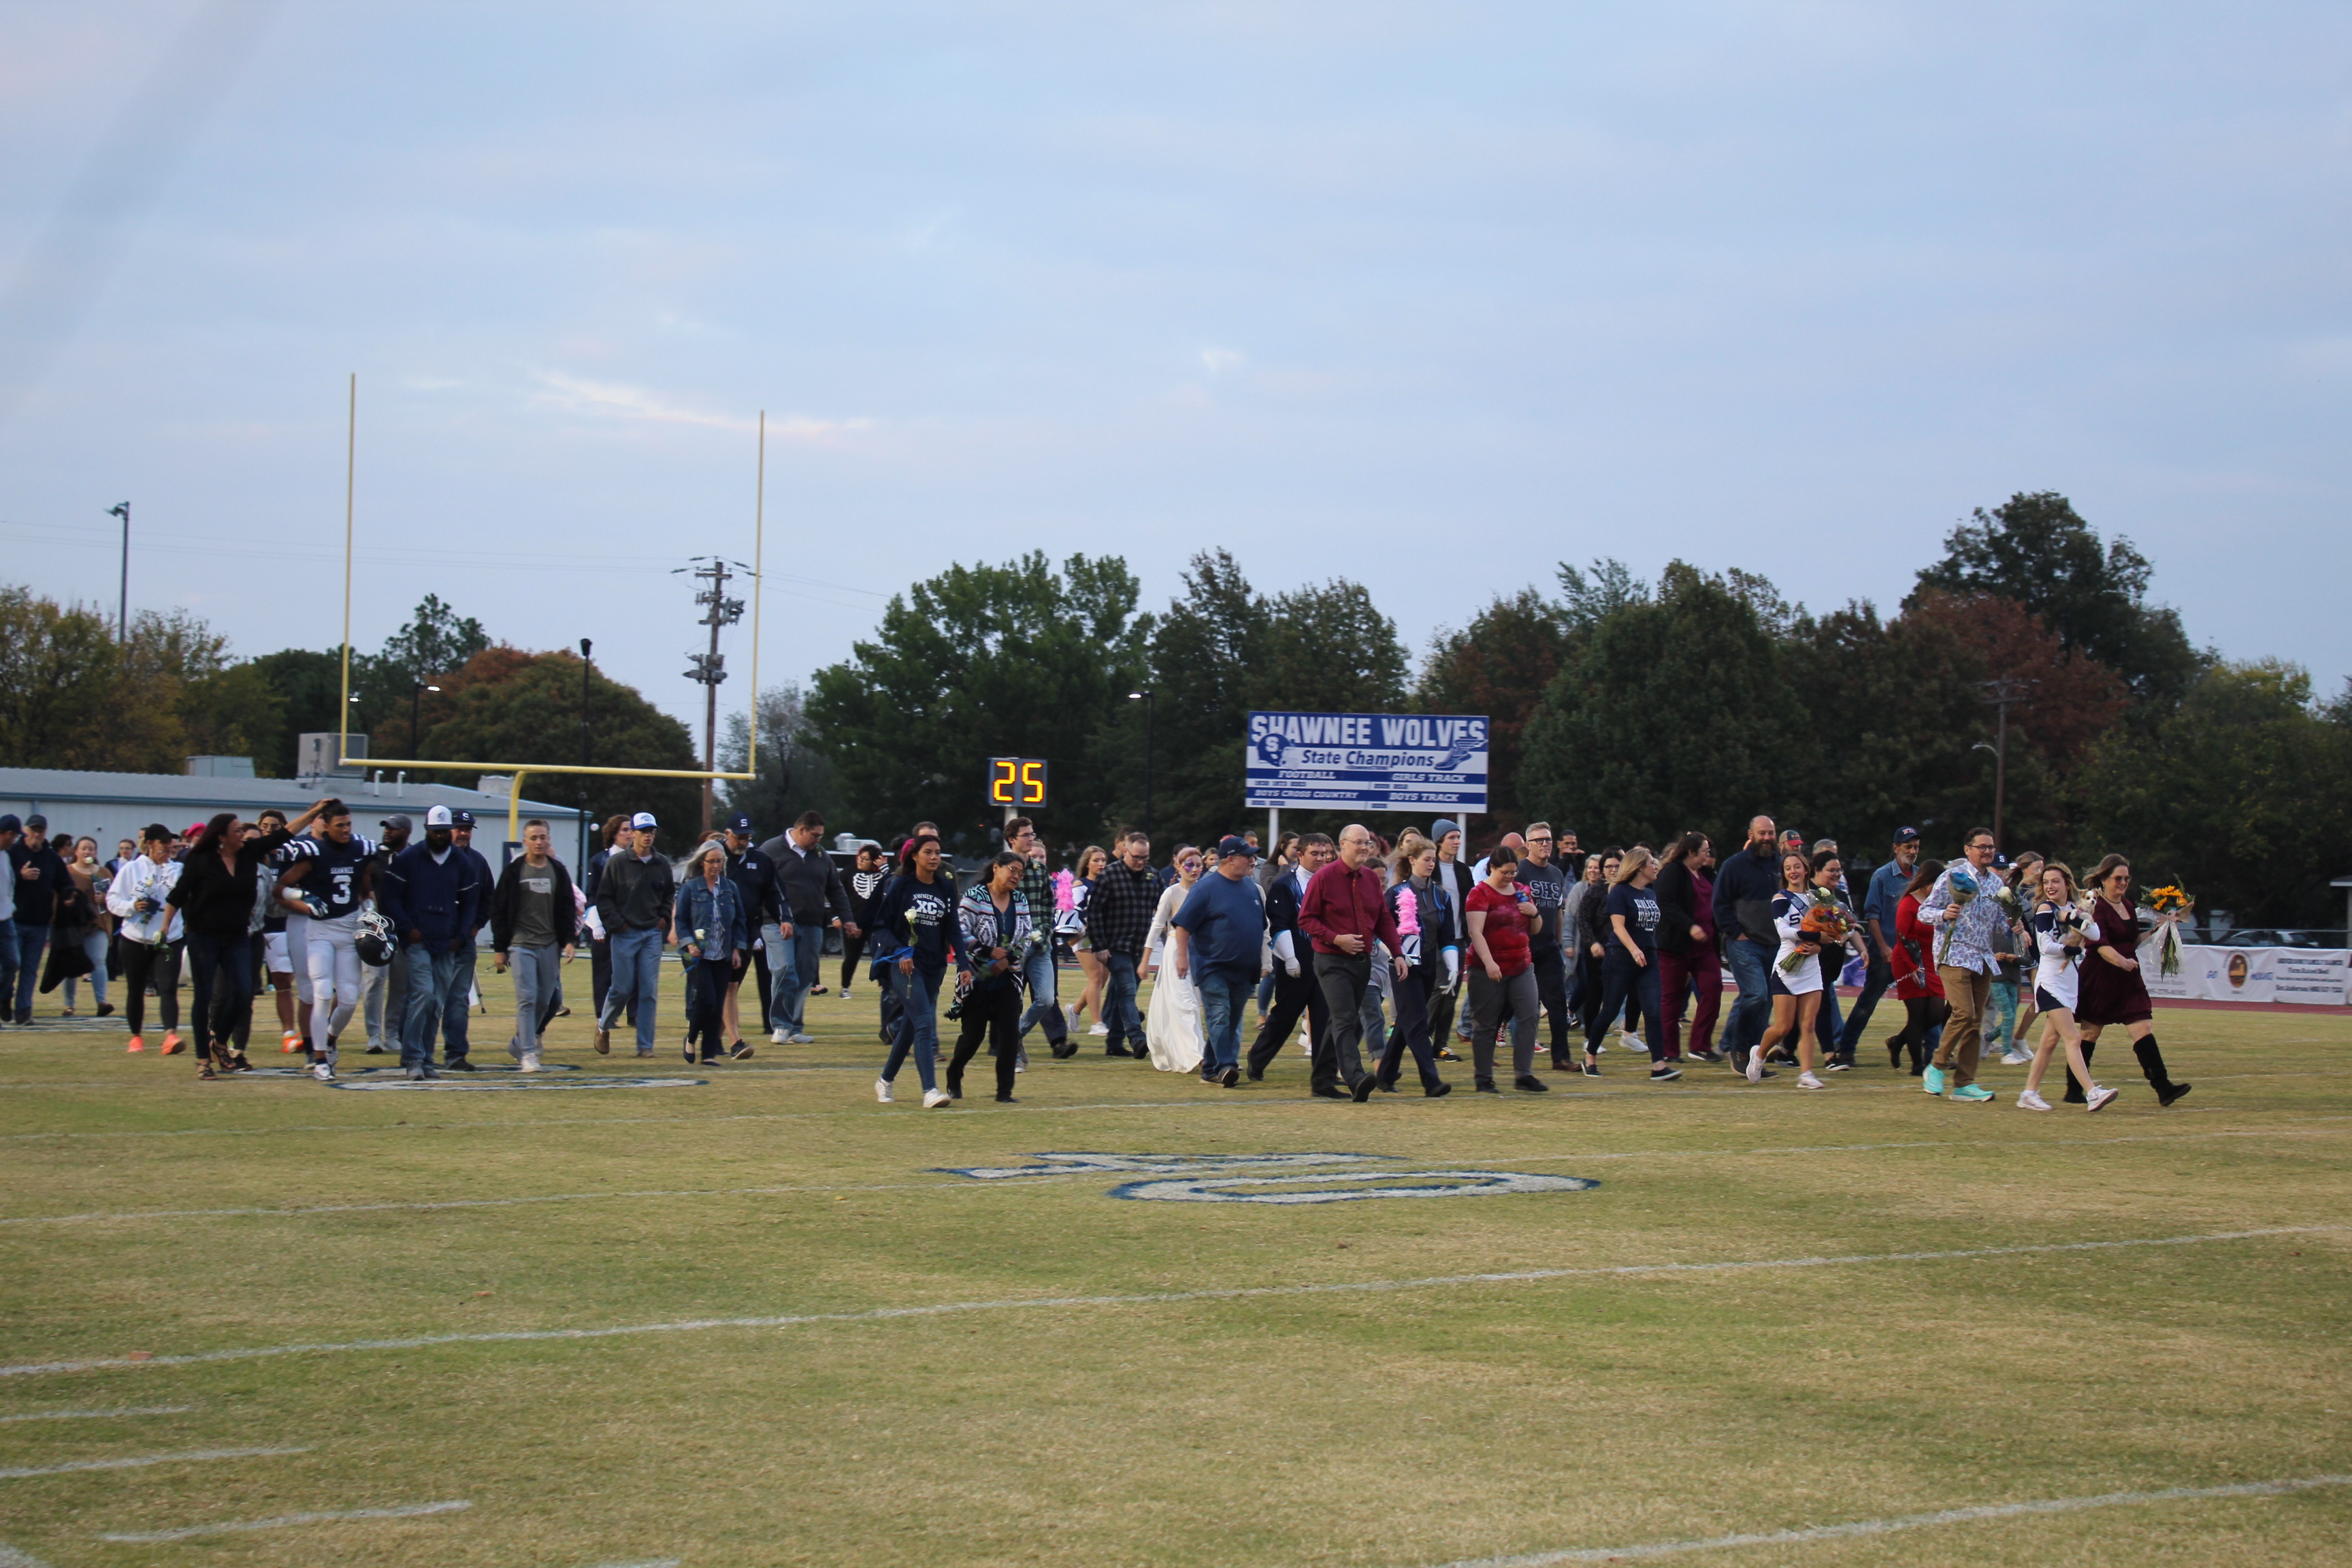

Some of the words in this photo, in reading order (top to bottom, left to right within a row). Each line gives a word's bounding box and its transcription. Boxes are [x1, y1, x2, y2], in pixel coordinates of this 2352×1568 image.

[1251, 715, 1372, 745] SHAWNEE
[1381, 718, 1486, 747] WOLVES
[1265, 736, 1279, 752] S
[1302, 750, 1341, 764] State
[1346, 751, 1434, 768] Champions
[994, 762, 1043, 802] 25
[1278, 770, 1336, 779] FOOTBALL
[1392, 773, 1426, 781] GIRLS
[1428, 774, 1467, 783] TRACK
[1313, 791, 1359, 799] COUNTRY
[1389, 792, 1420, 800] BOYS
[1422, 793, 1460, 802] TRACK
[740, 819, 748, 827] S
[332, 875, 352, 904] 3
[1529, 881, 1559, 900] SHS
[916, 900, 938, 915] XC
